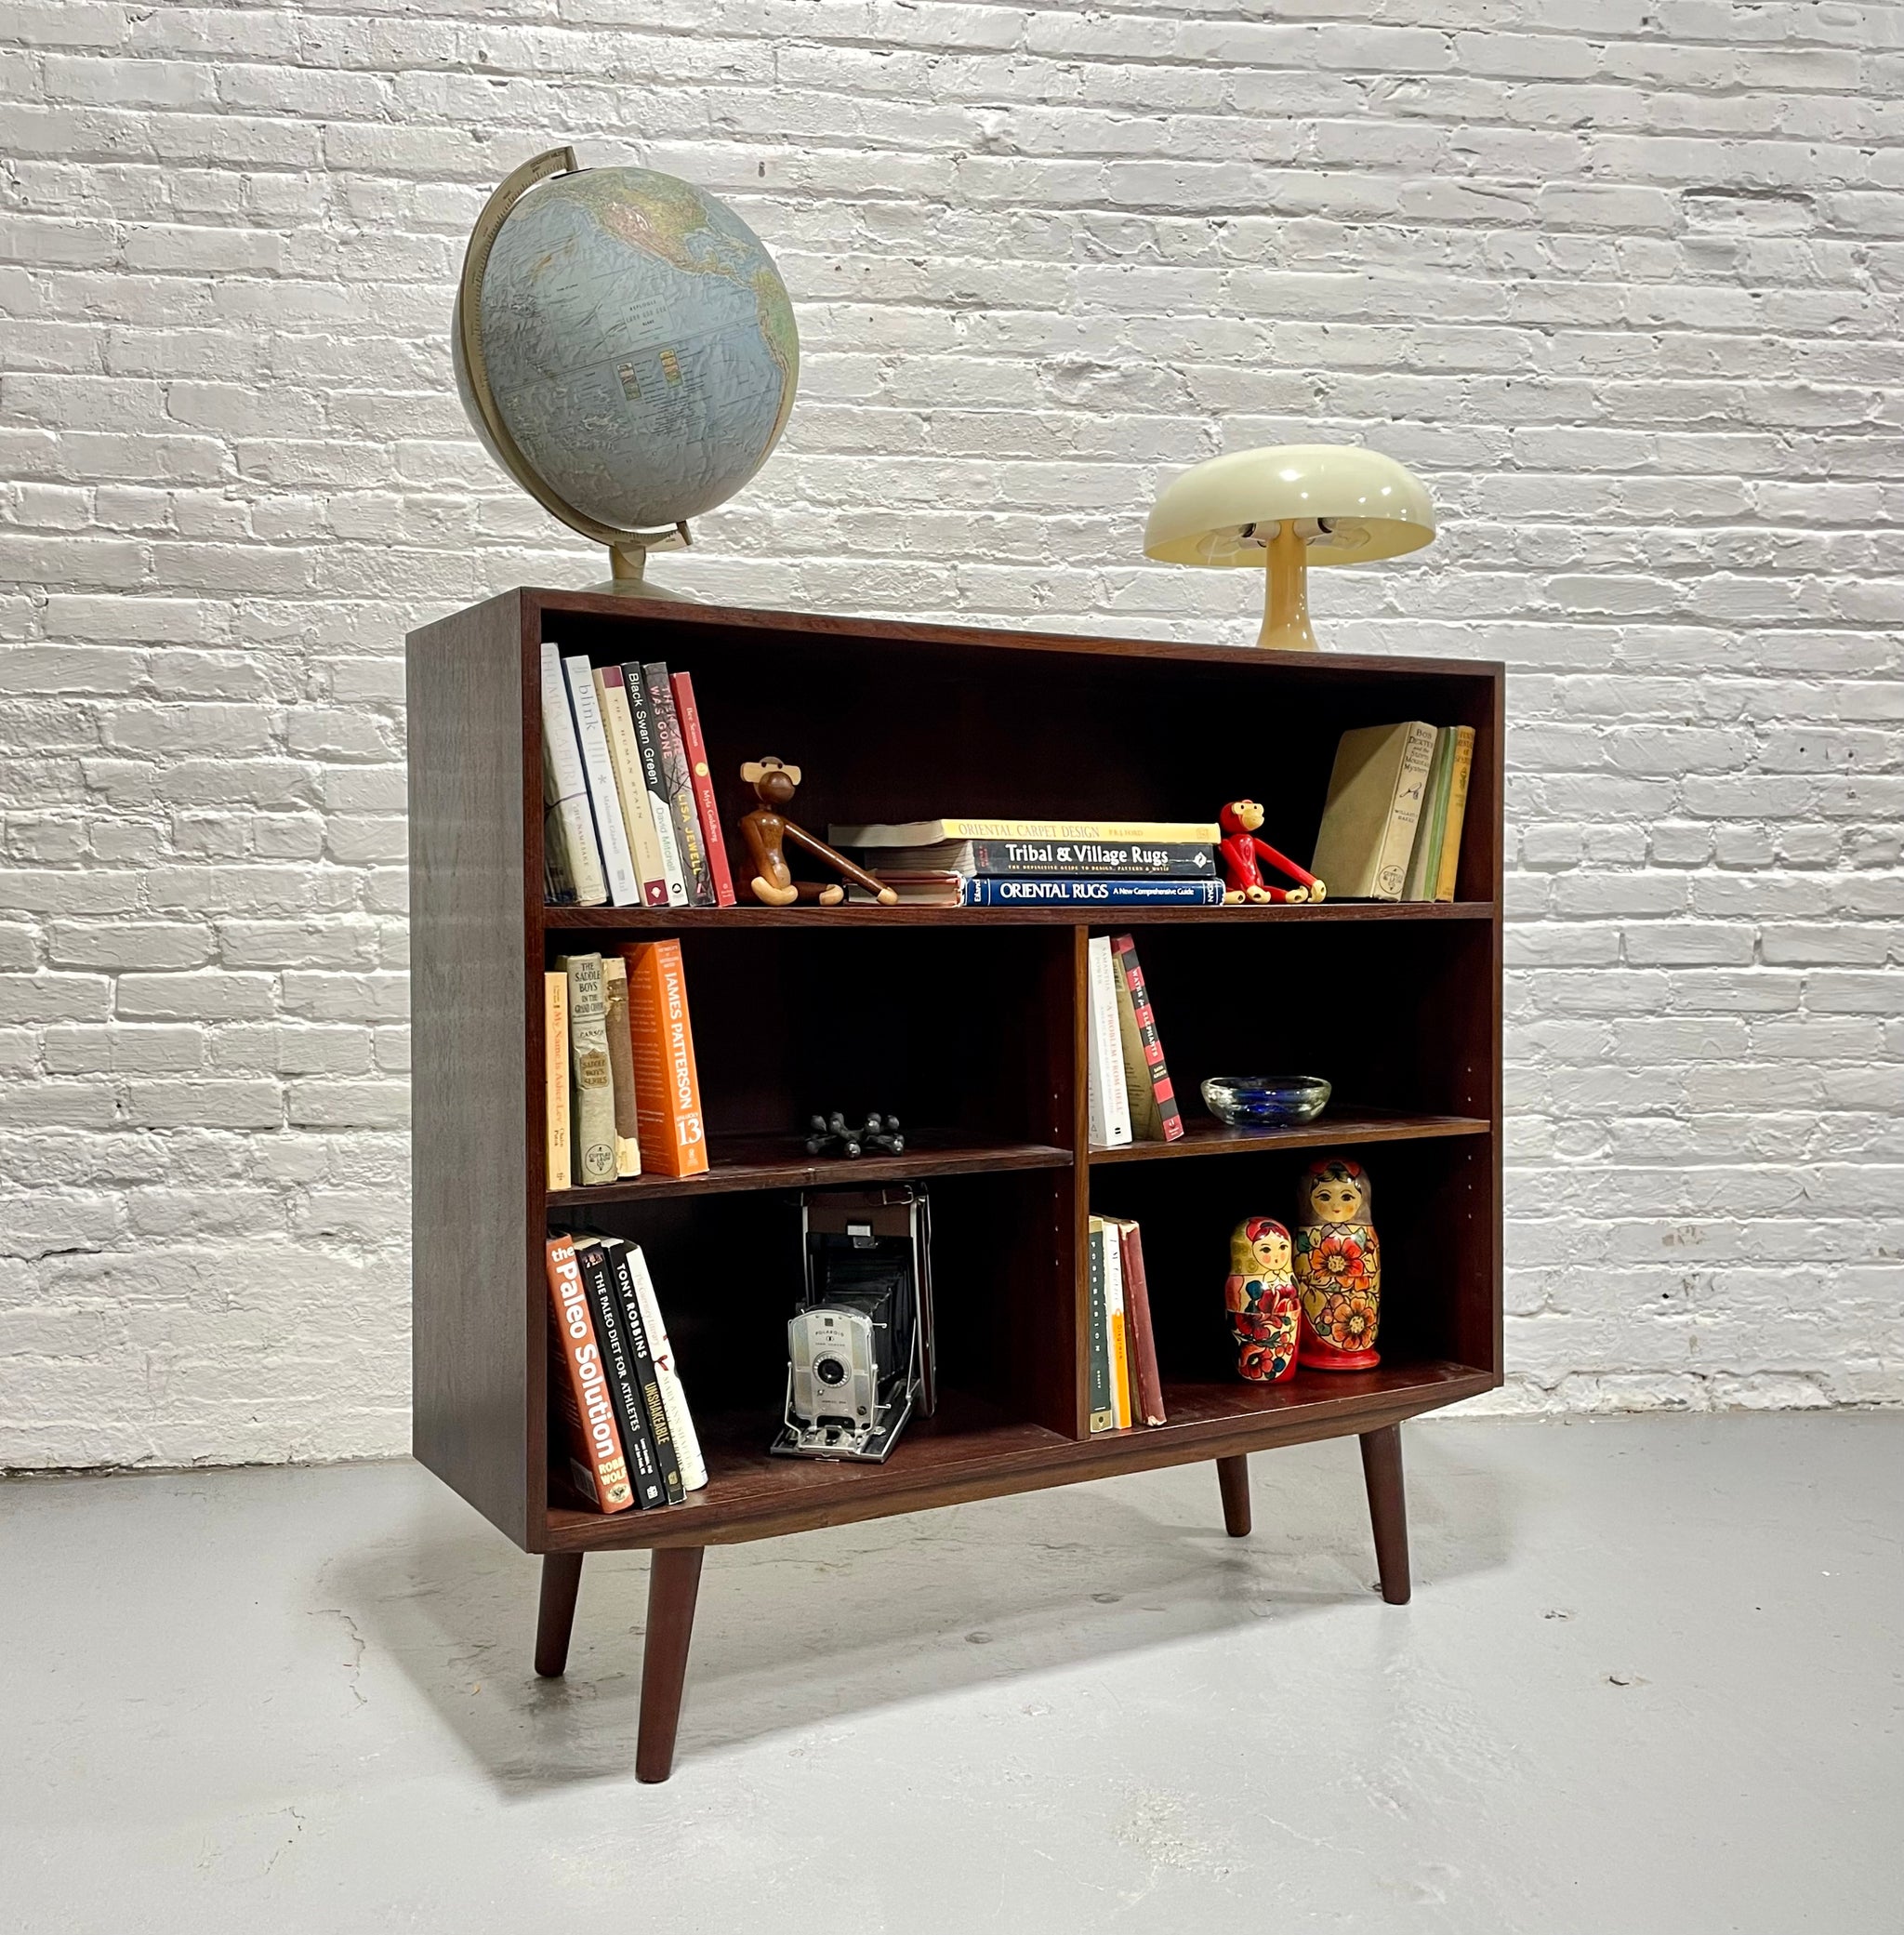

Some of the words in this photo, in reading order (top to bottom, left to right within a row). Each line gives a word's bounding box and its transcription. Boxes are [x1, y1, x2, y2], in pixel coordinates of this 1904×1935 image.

[628, 672, 642, 708] Black
[650, 685, 664, 716] WAS
[578, 684, 599, 731] blink
[636, 710, 651, 745] Swan
[656, 721, 673, 760] GONE
[643, 748, 658, 785] Green
[655, 807, 668, 834] David
[677, 793, 691, 823] LISA
[684, 827, 703, 876] JEWELL
[958, 823, 1012, 836] ORIENTAL
[1017, 824, 1057, 838] CARPET
[1062, 825, 1100, 839] DESIGN
[661, 835, 677, 872] Mitchell
[1005, 843, 1052, 863] Tribal
[1056, 847, 1073, 863] &
[1073, 844, 1128, 867] Village
[1131, 845, 1169, 867] Rugs
[1000, 882, 1069, 899] ORIENTAL
[1073, 883, 1109, 899] RUGS
[1113, 887, 1119, 895] A
[1120, 887, 1133, 895] New
[1133, 887, 1177, 897] Comprehensive
[1178, 887, 1195, 896] Guide
[575, 970, 601, 982] SADDLE
[581, 962, 594, 972] THE
[579, 981, 598, 993] BOYS
[664, 973, 682, 1020] JAMES
[1131, 969, 1144, 998] WATER
[1142, 1011, 1158, 1057] ELEPHANTS
[670, 1023, 693, 1110] PATTERSON
[677, 1118, 702, 1146] 13
[551, 1246, 575, 1263] the
[595, 1271, 607, 1295] THE
[600, 1295, 615, 1328] PALEO
[616, 1263, 633, 1297] TONY
[626, 1302, 648, 1359] ROBBINS
[608, 1329, 622, 1355] DIET
[556, 1260, 588, 1339] Paleo
[575, 1343, 615, 1459] Solution
[615, 1356, 628, 1379] FOR
[620, 1382, 641, 1432] ATHLETES
[643, 1381, 670, 1446] UNSHAKEABLE
[663, 1376, 675, 1402] MARY
[670, 1405, 681, 1425] ANN
[601, 1466, 627, 1486] WOLF
